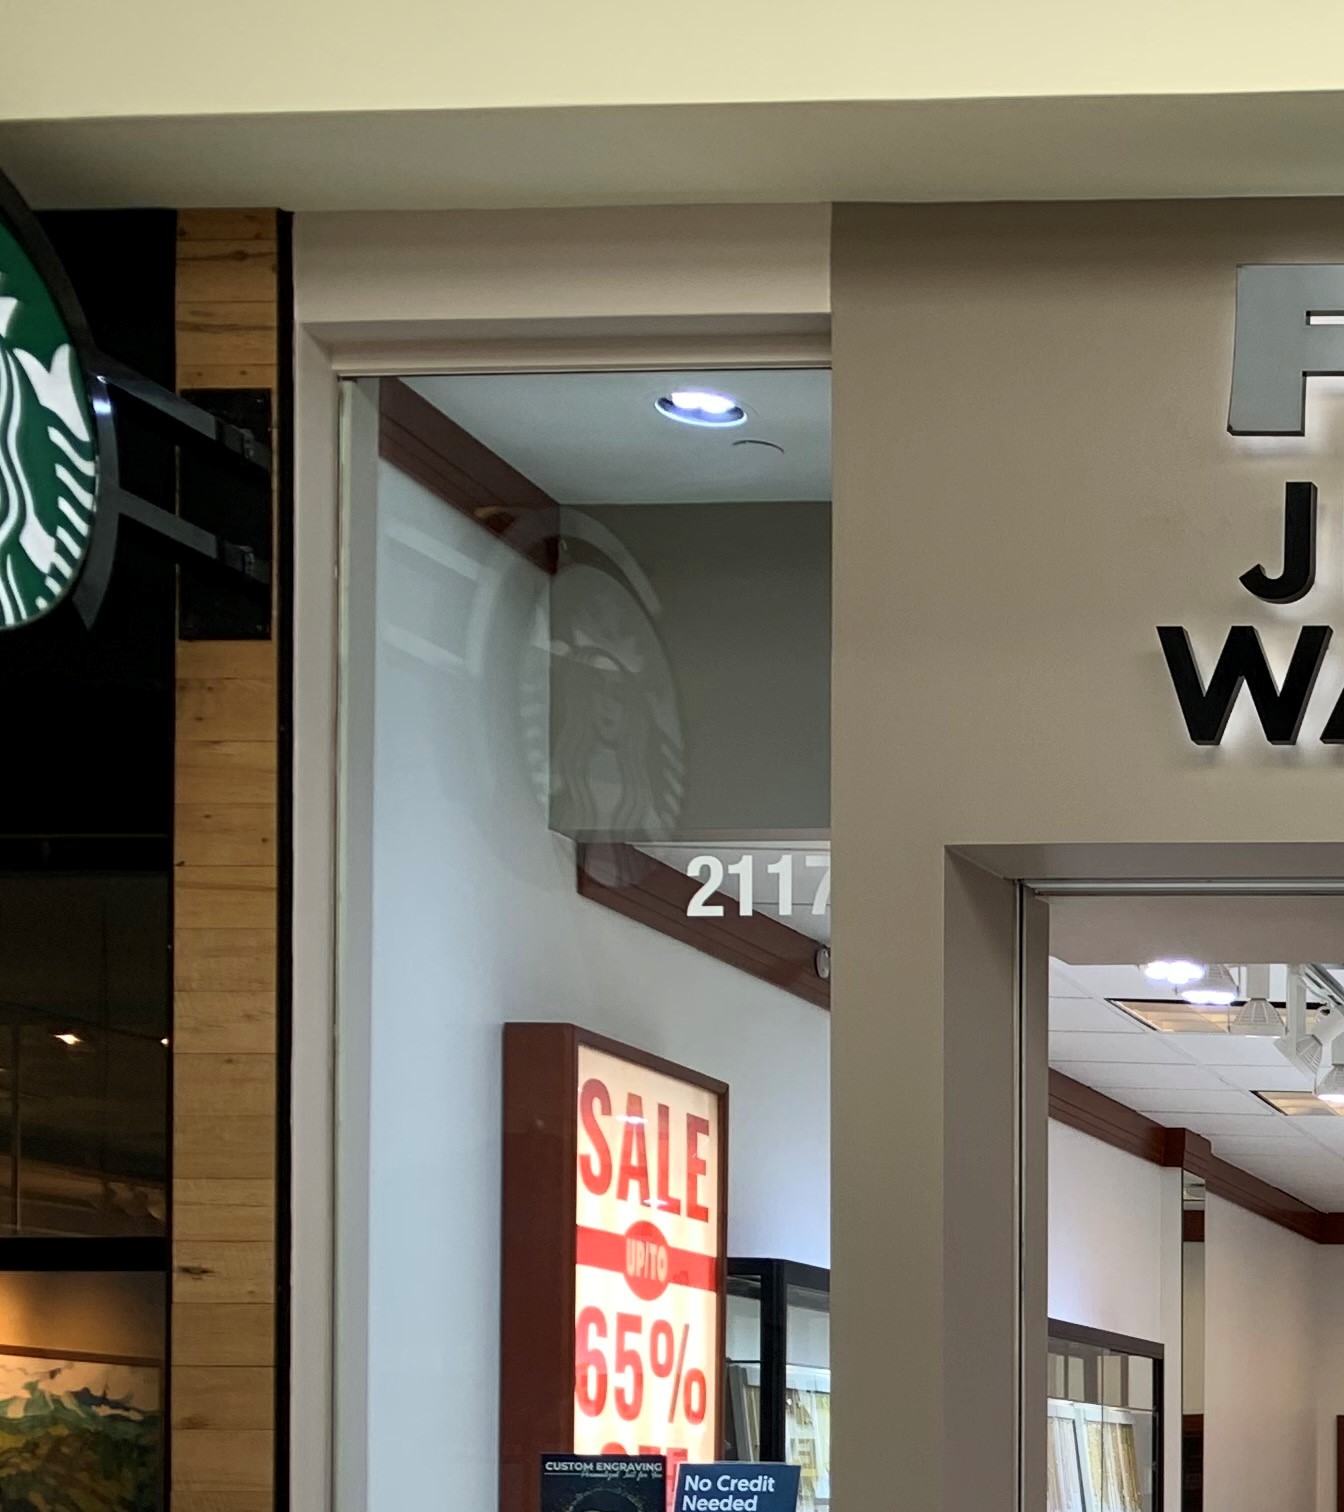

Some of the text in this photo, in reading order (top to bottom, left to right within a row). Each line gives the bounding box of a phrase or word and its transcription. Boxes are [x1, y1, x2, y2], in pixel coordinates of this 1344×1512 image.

[686, 854, 832, 917] 2117
[578, 1078, 710, 1224] SALE
[574, 1305, 707, 1426] 65%
[545, 1462, 662, 1472] CUSTOM ENGRAVING
[684, 1475, 775, 1493] No Credit
[682, 1495, 758, 1512] Needed
